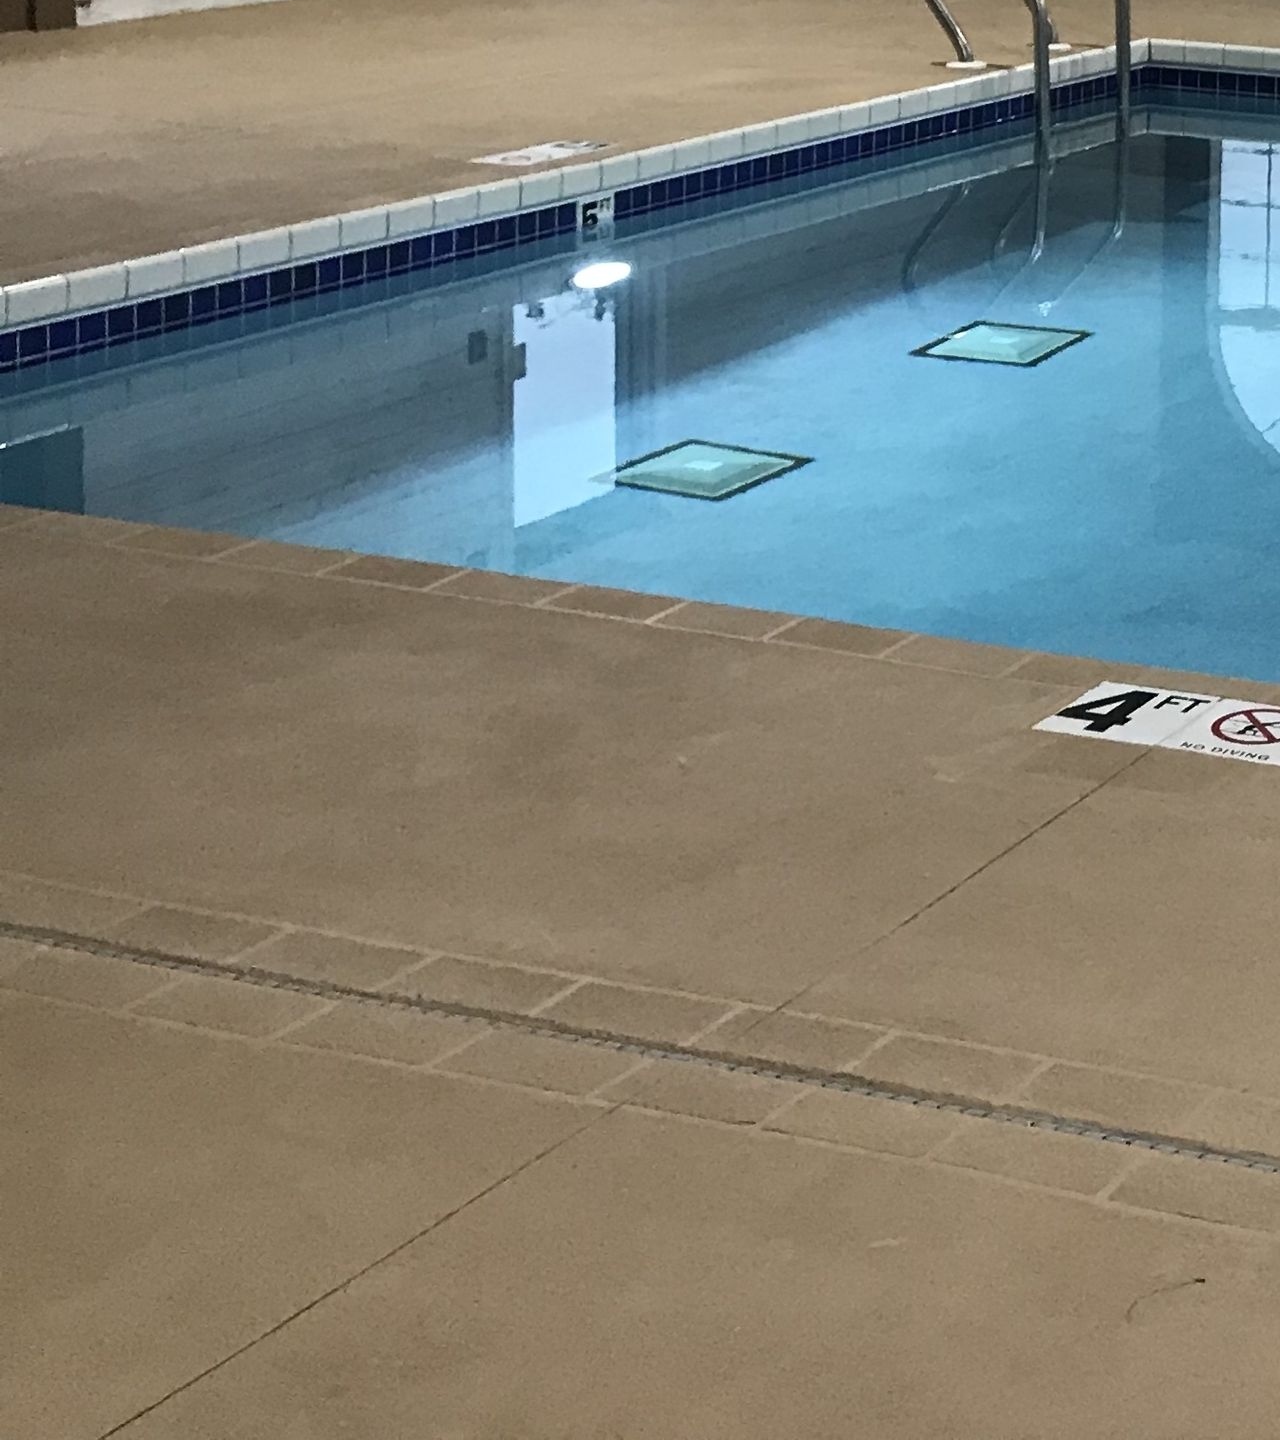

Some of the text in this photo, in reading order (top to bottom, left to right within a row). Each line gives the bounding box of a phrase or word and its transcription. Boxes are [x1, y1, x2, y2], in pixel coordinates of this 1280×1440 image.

[1056, 690, 1212, 733] 4 FT
[1180, 741, 1270, 761] NO DIVING
